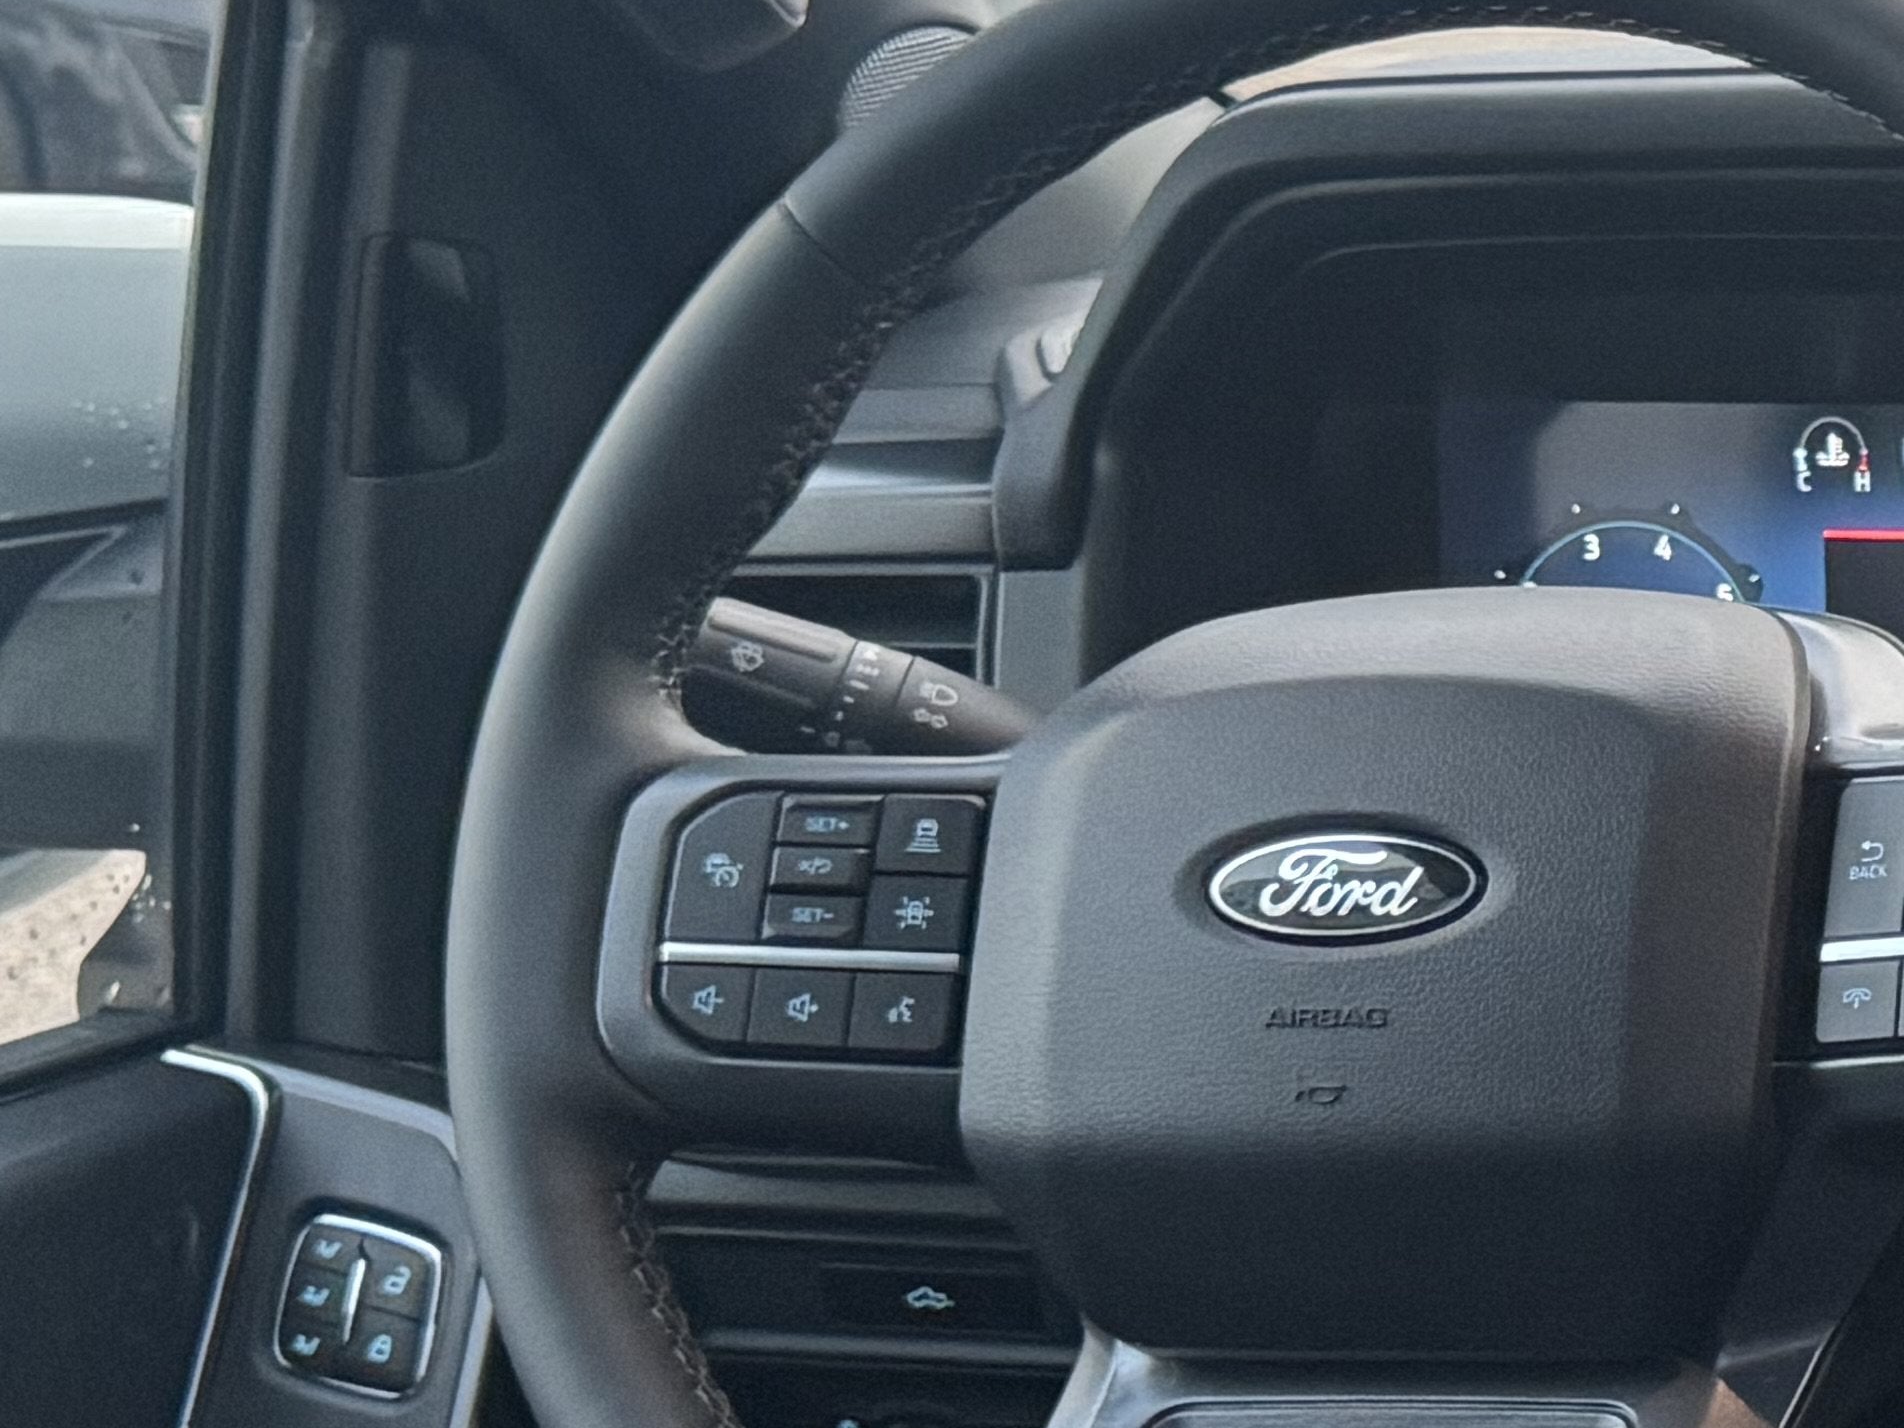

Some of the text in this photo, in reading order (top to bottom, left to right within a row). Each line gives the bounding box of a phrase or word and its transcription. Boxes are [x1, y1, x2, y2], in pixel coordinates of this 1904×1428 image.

[1796, 471, 1871, 492] C H
[1582, 534, 1601, 561] 3
[1653, 534, 1673, 562] 4
[1258, 848, 1425, 917] Ford
[1848, 864, 1889, 881] BACK
[1265, 1007, 1391, 1030] AIRBAG
